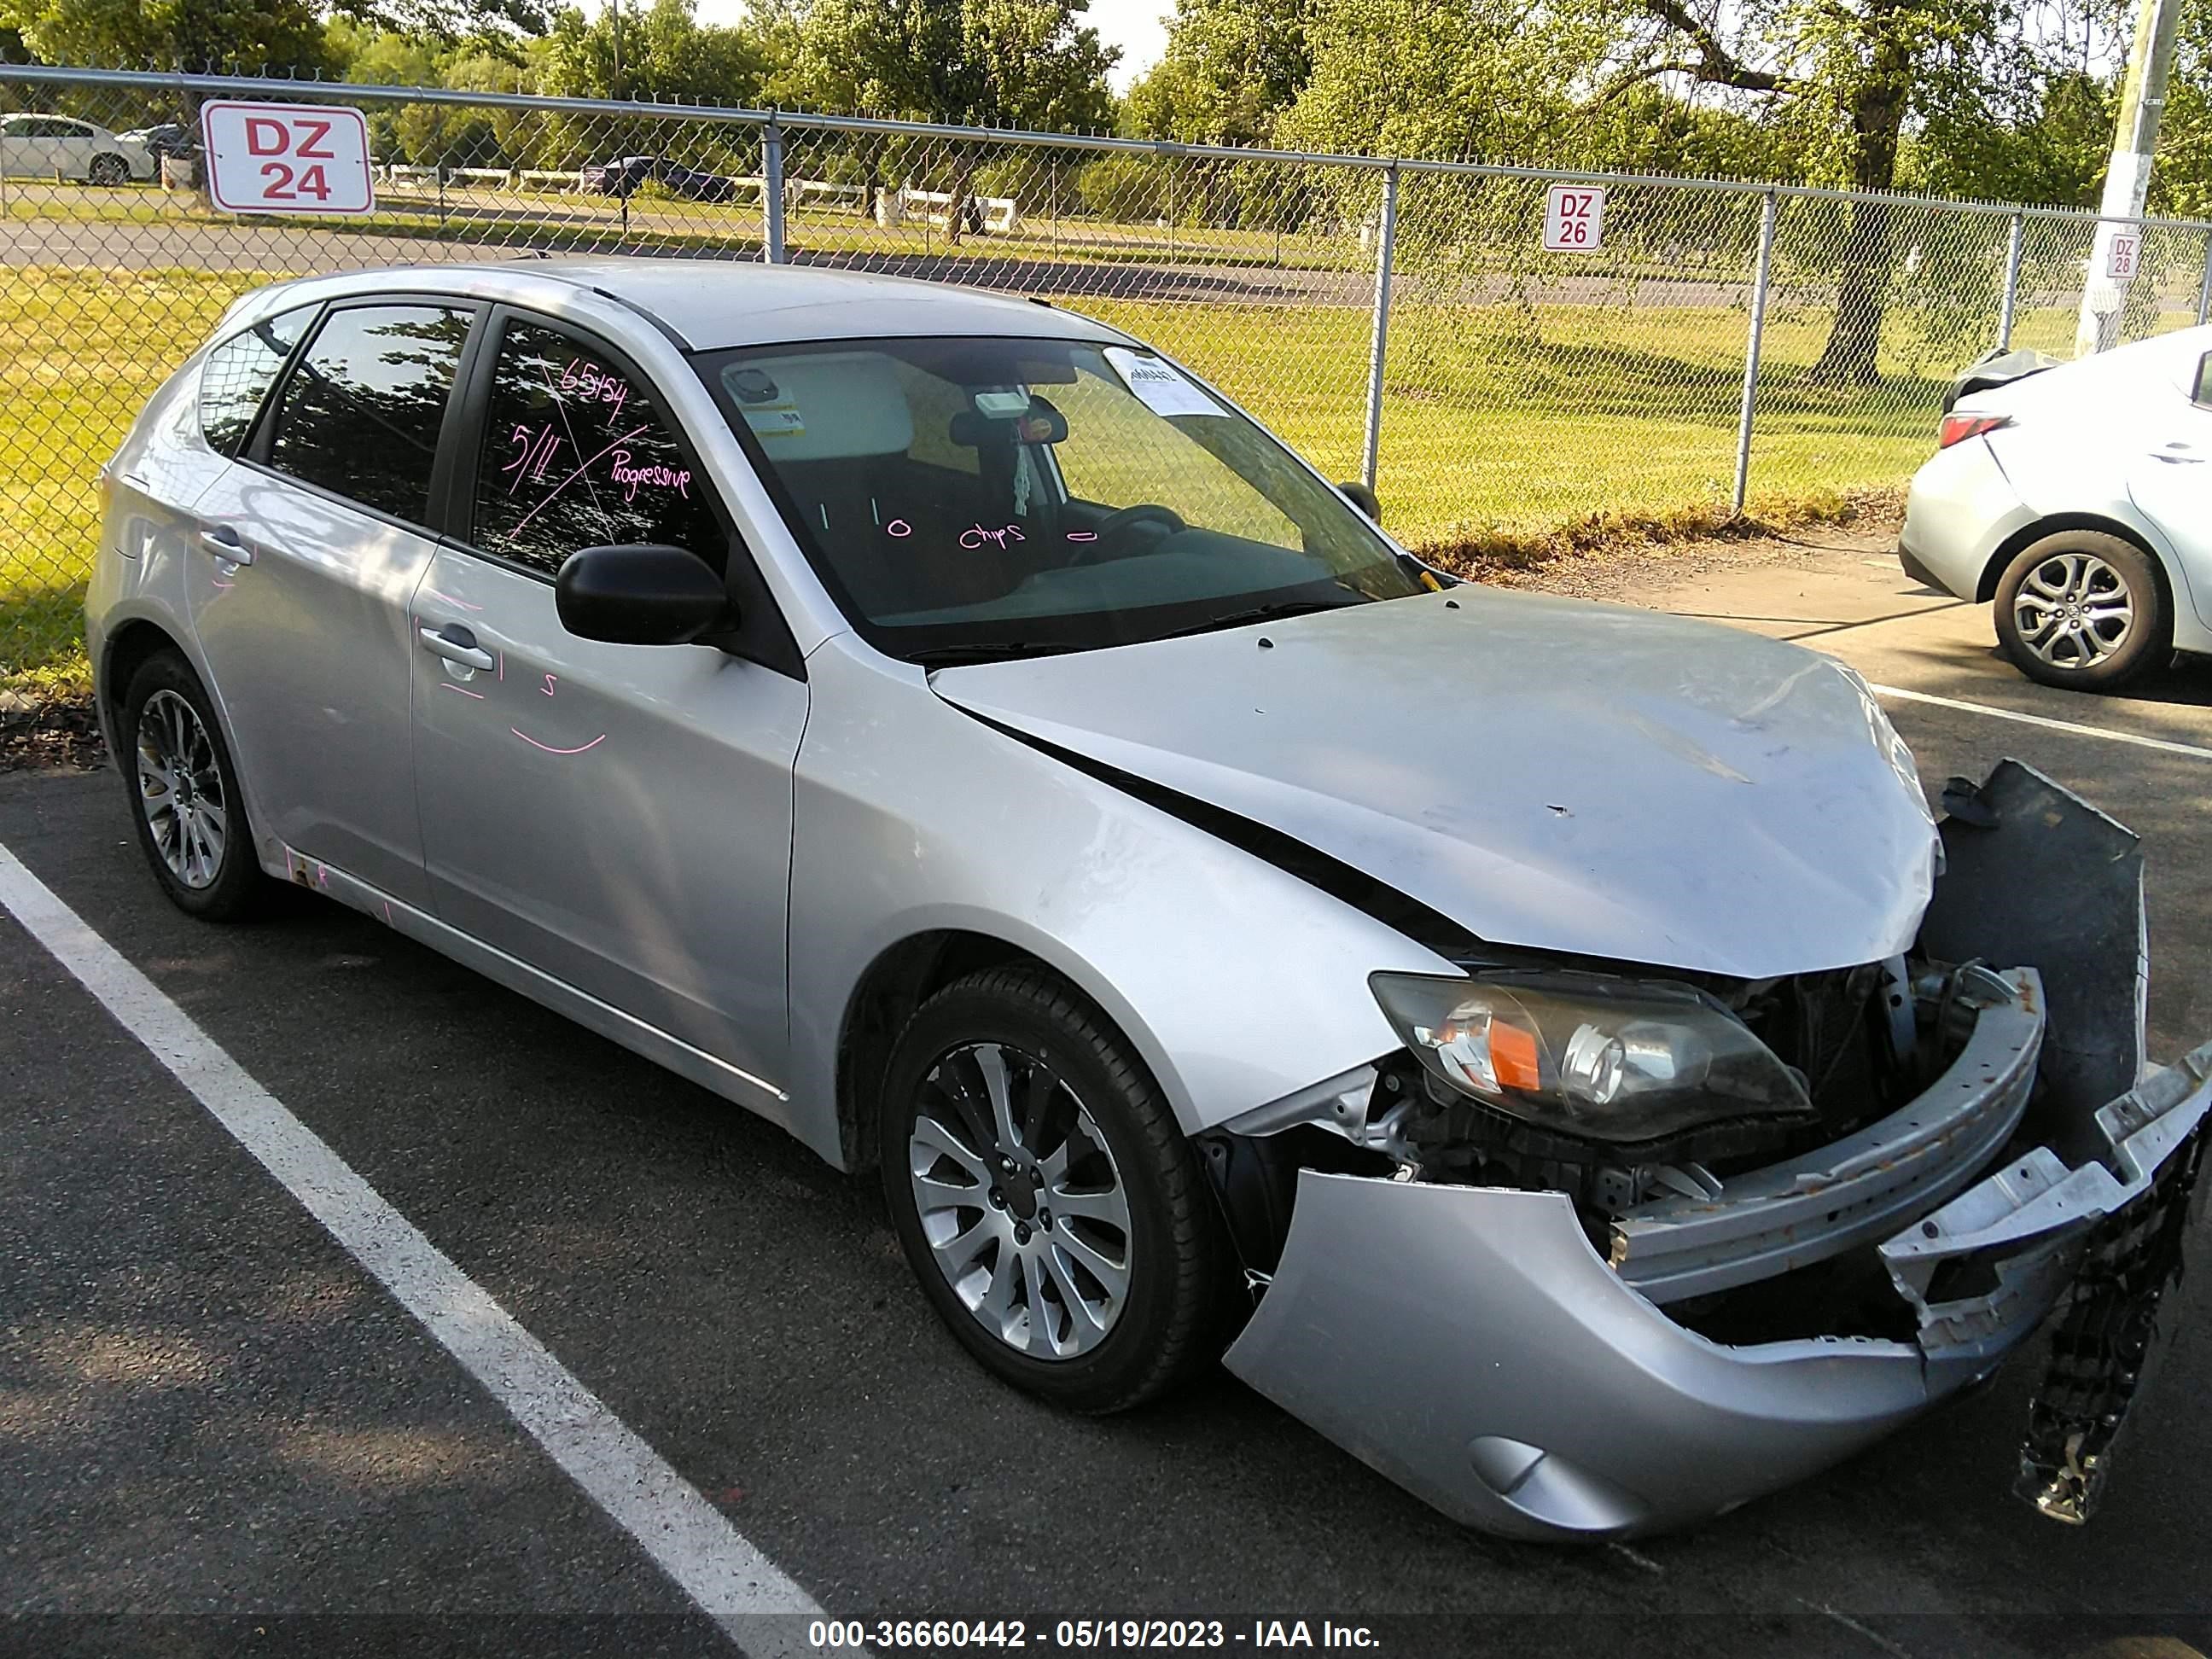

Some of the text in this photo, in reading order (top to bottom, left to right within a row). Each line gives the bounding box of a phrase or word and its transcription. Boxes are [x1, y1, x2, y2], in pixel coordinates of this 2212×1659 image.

[245, 118, 335, 159] DZ
[260, 162, 332, 201] 24
[1560, 195, 1592, 218] DZ
[1559, 220, 1587, 242] 26
[2116, 239, 2134, 256] DZ
[2115, 257, 2130, 273] 28
